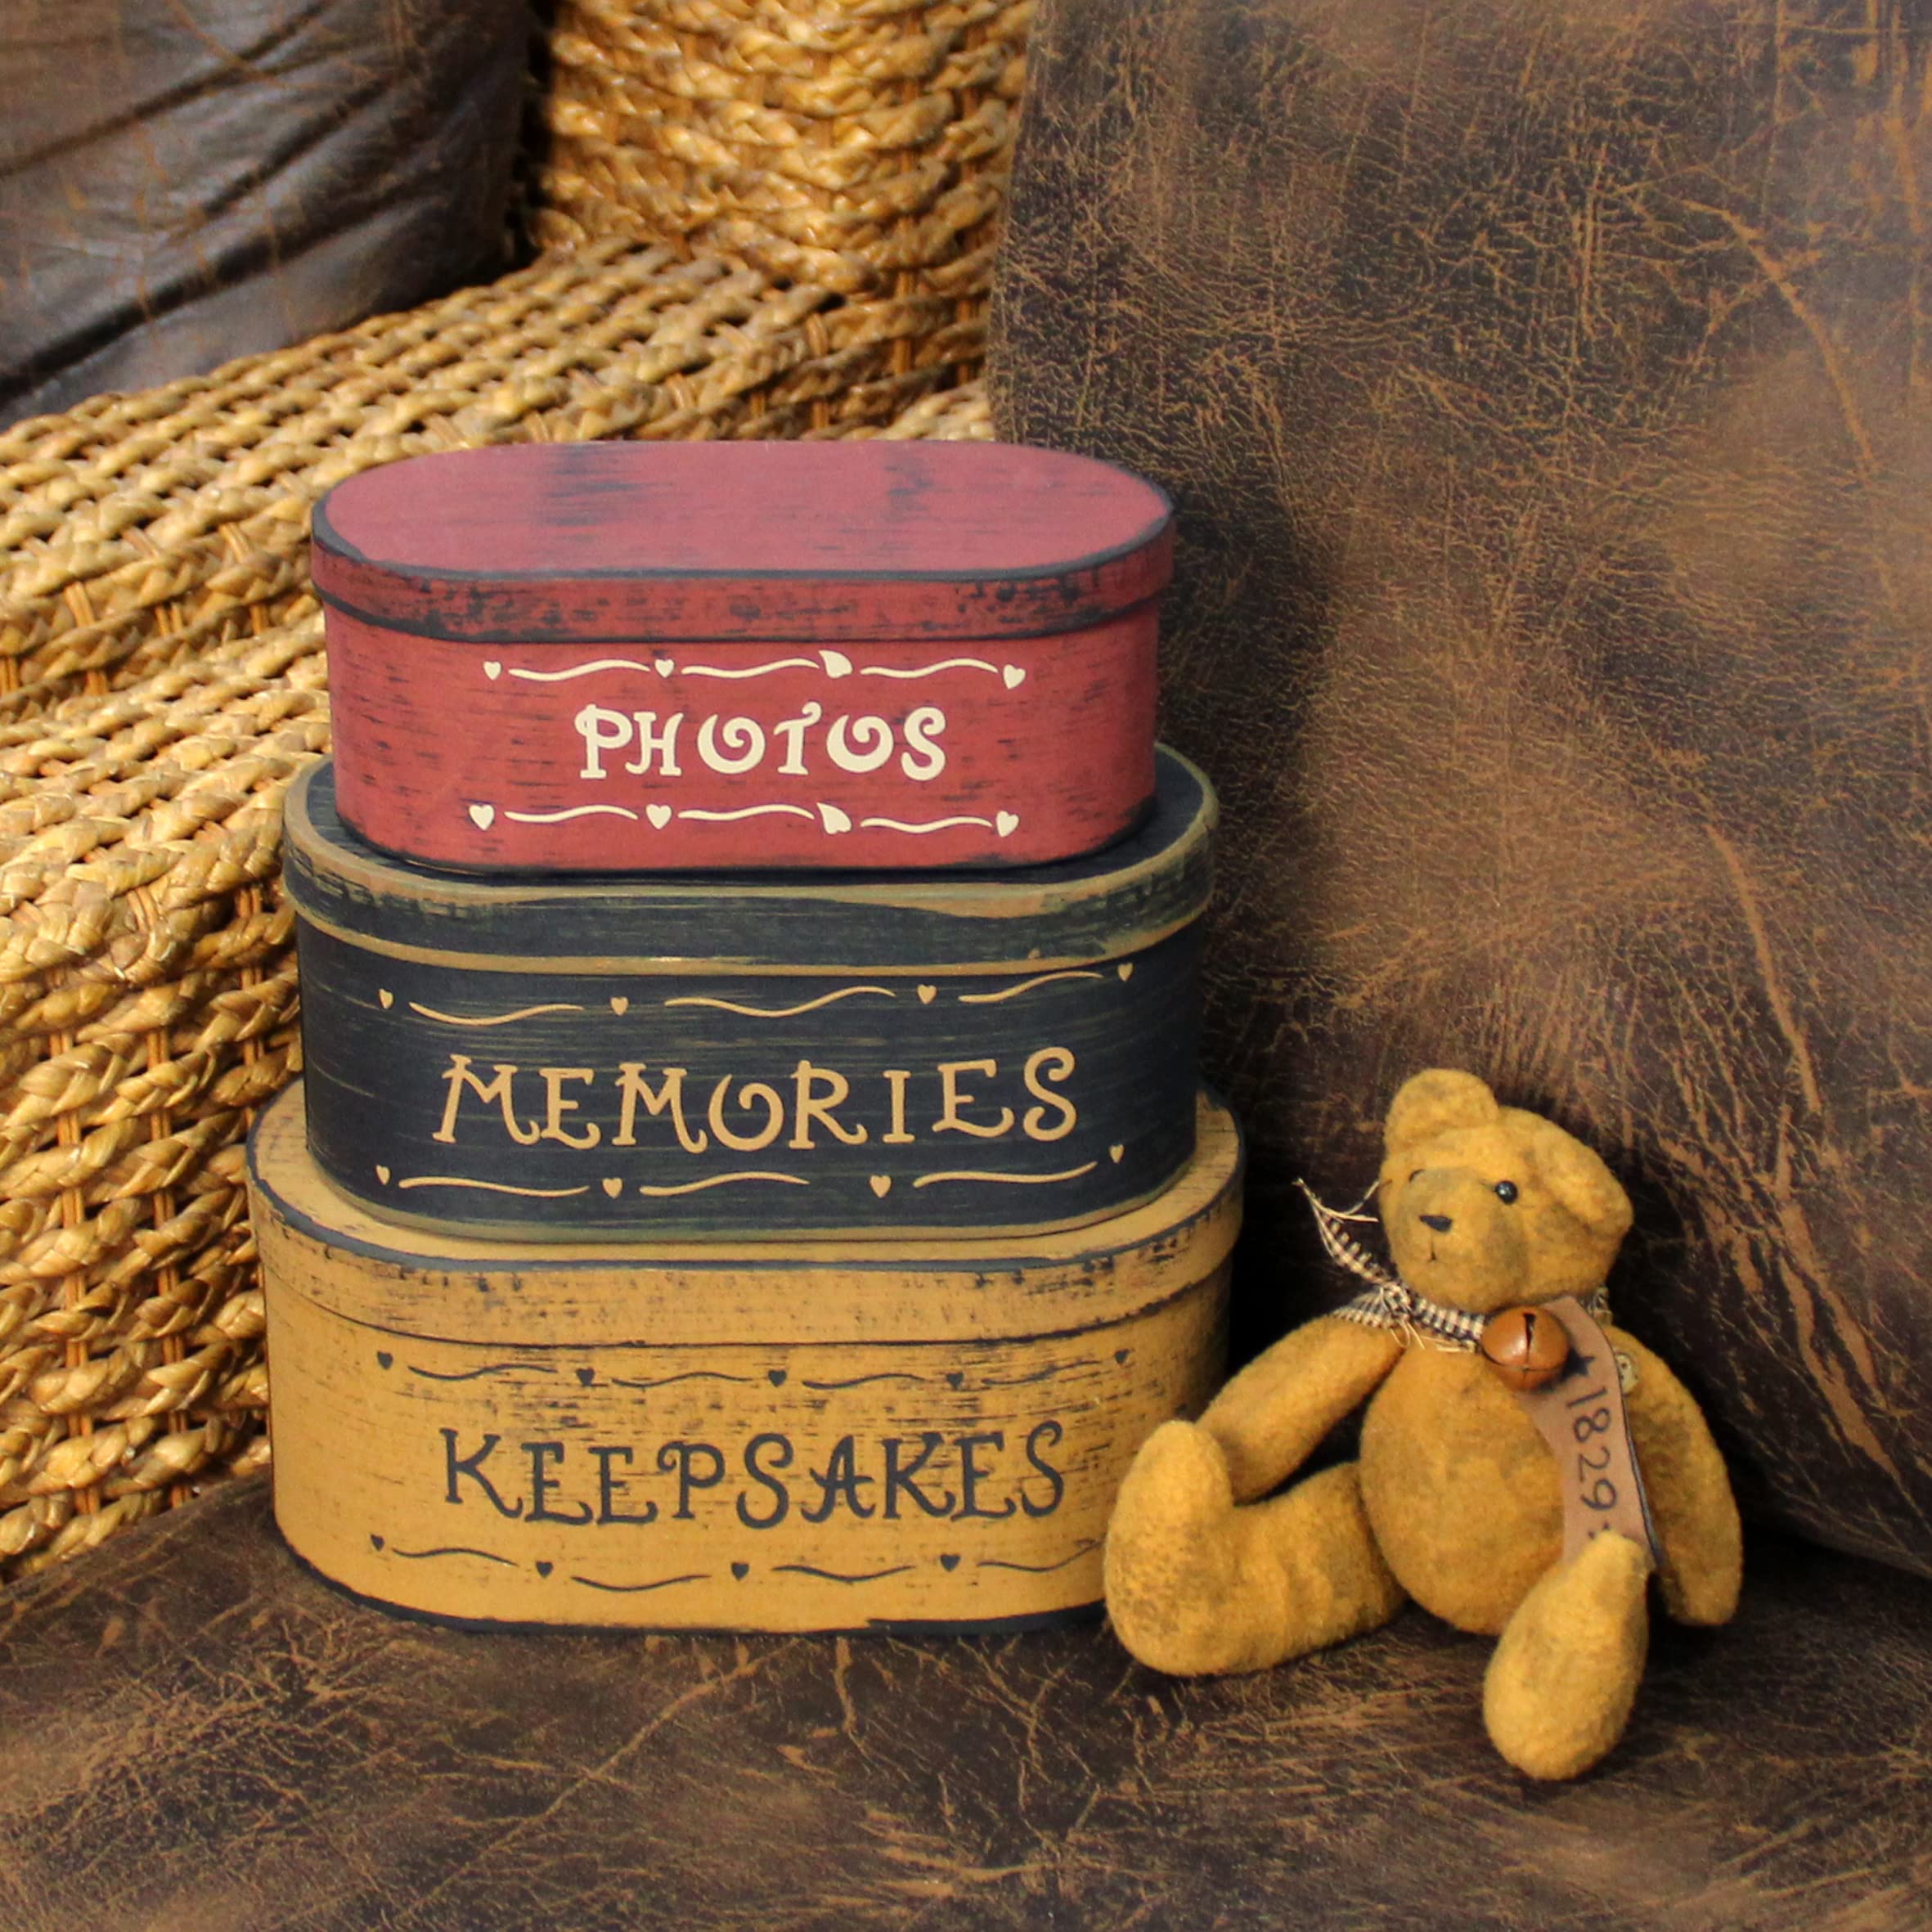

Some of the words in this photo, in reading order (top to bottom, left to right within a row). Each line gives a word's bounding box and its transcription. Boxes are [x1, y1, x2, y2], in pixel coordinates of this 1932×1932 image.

[574, 701, 946, 781] PHOTOS
[432, 1046, 1077, 1154] MEMORIES
[438, 1420, 1063, 1529] KEEPSAKES
[1566, 1386, 1618, 1512] 1829
